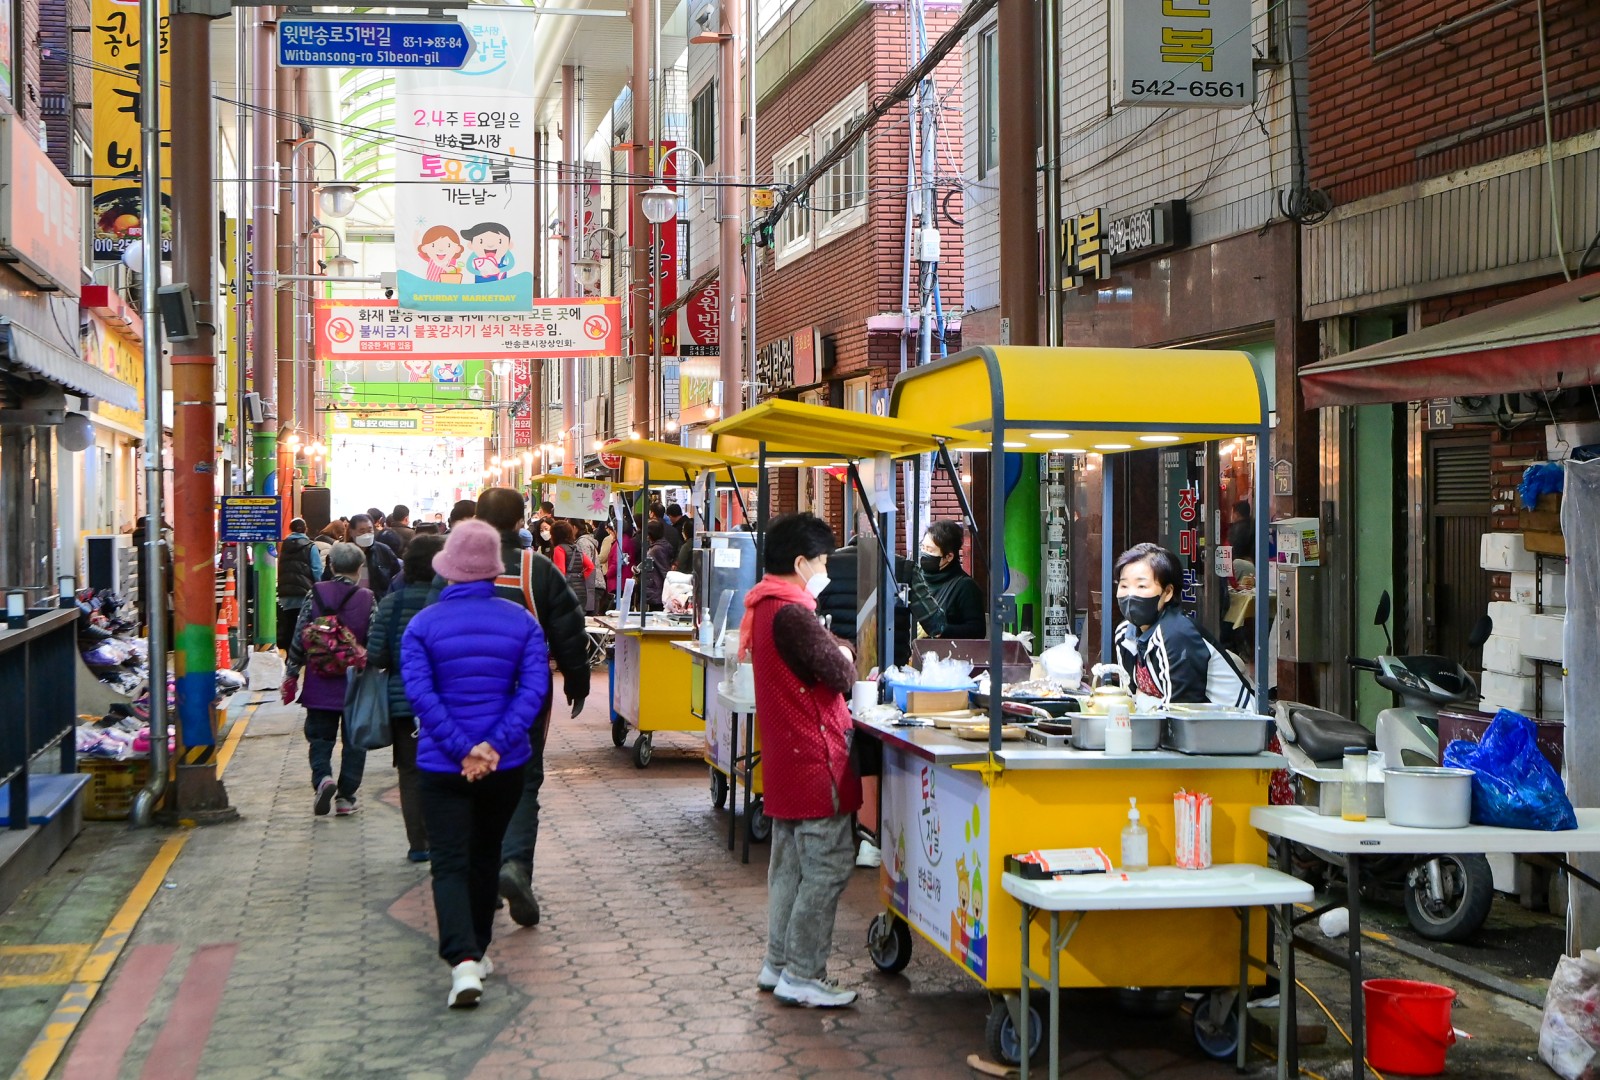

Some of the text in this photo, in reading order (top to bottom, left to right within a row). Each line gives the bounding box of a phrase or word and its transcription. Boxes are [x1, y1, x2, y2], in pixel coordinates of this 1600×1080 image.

[283, 25, 462, 48] 윗반송로51번길 83-1 83-84
[285, 50, 440, 65] Witbansong-ro 51beon-gil
[1131, 80, 1244, 97] 542-6561
[434, 133, 501, 150] 반송큰시장
[1109, 212, 1151, 255] 542-6561
[413, 294, 516, 302] SATURDAY MARKETDAY
[359, 309, 384, 322] 화재
[557, 307, 581, 320] 곳에
[359, 323, 562, 338] 불씨금지 불꽃감지기 설치 작동중임.
[1435, 409, 1446, 424] 81
[1279, 478, 1288, 492] 79
